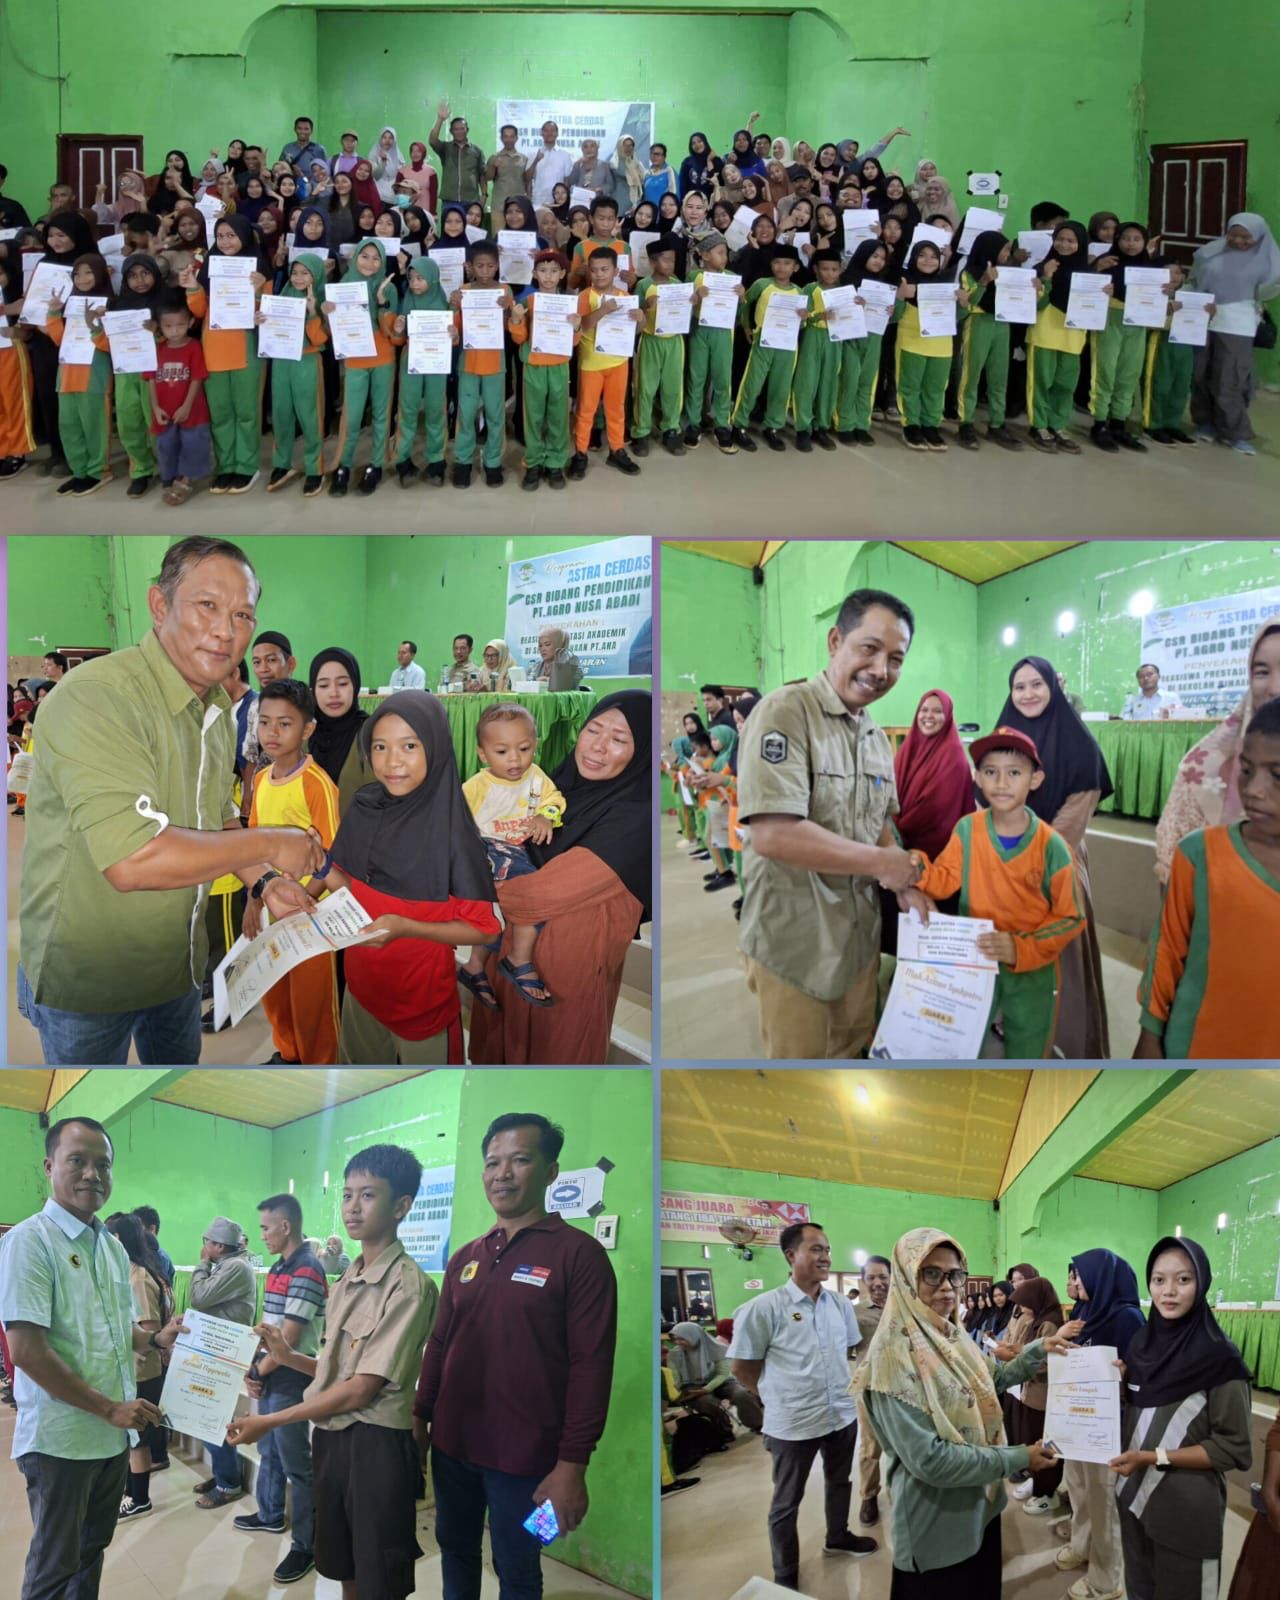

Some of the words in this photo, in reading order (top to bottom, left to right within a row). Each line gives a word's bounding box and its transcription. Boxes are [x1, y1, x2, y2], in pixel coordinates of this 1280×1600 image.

[567, 564, 601, 583] ASTRA
[604, 555, 651, 577] CERDAS
[525, 593, 542, 606] CSR
[545, 586, 581, 604] BIDANG
[584, 575, 652, 597] PENDIDIKAN
[532, 603, 572, 618] PT.AGRO
[575, 598, 601, 613] NUSA
[606, 593, 641, 610] ABADI
[1218, 609, 1257, 624] ASTRA
[587, 628, 626, 639] AKADEMIK
[1164, 636, 1186, 648] CSR
[1190, 627, 1235, 644] BIDANG
[590, 641, 617, 651] PT.ANA
[1175, 642, 1225, 659] PT.AGRO
[1203, 667, 1247, 679] PRESTASI
[696, 1200, 735, 1214] JUARA
[747, 1217, 773, 1228] ETAPI
